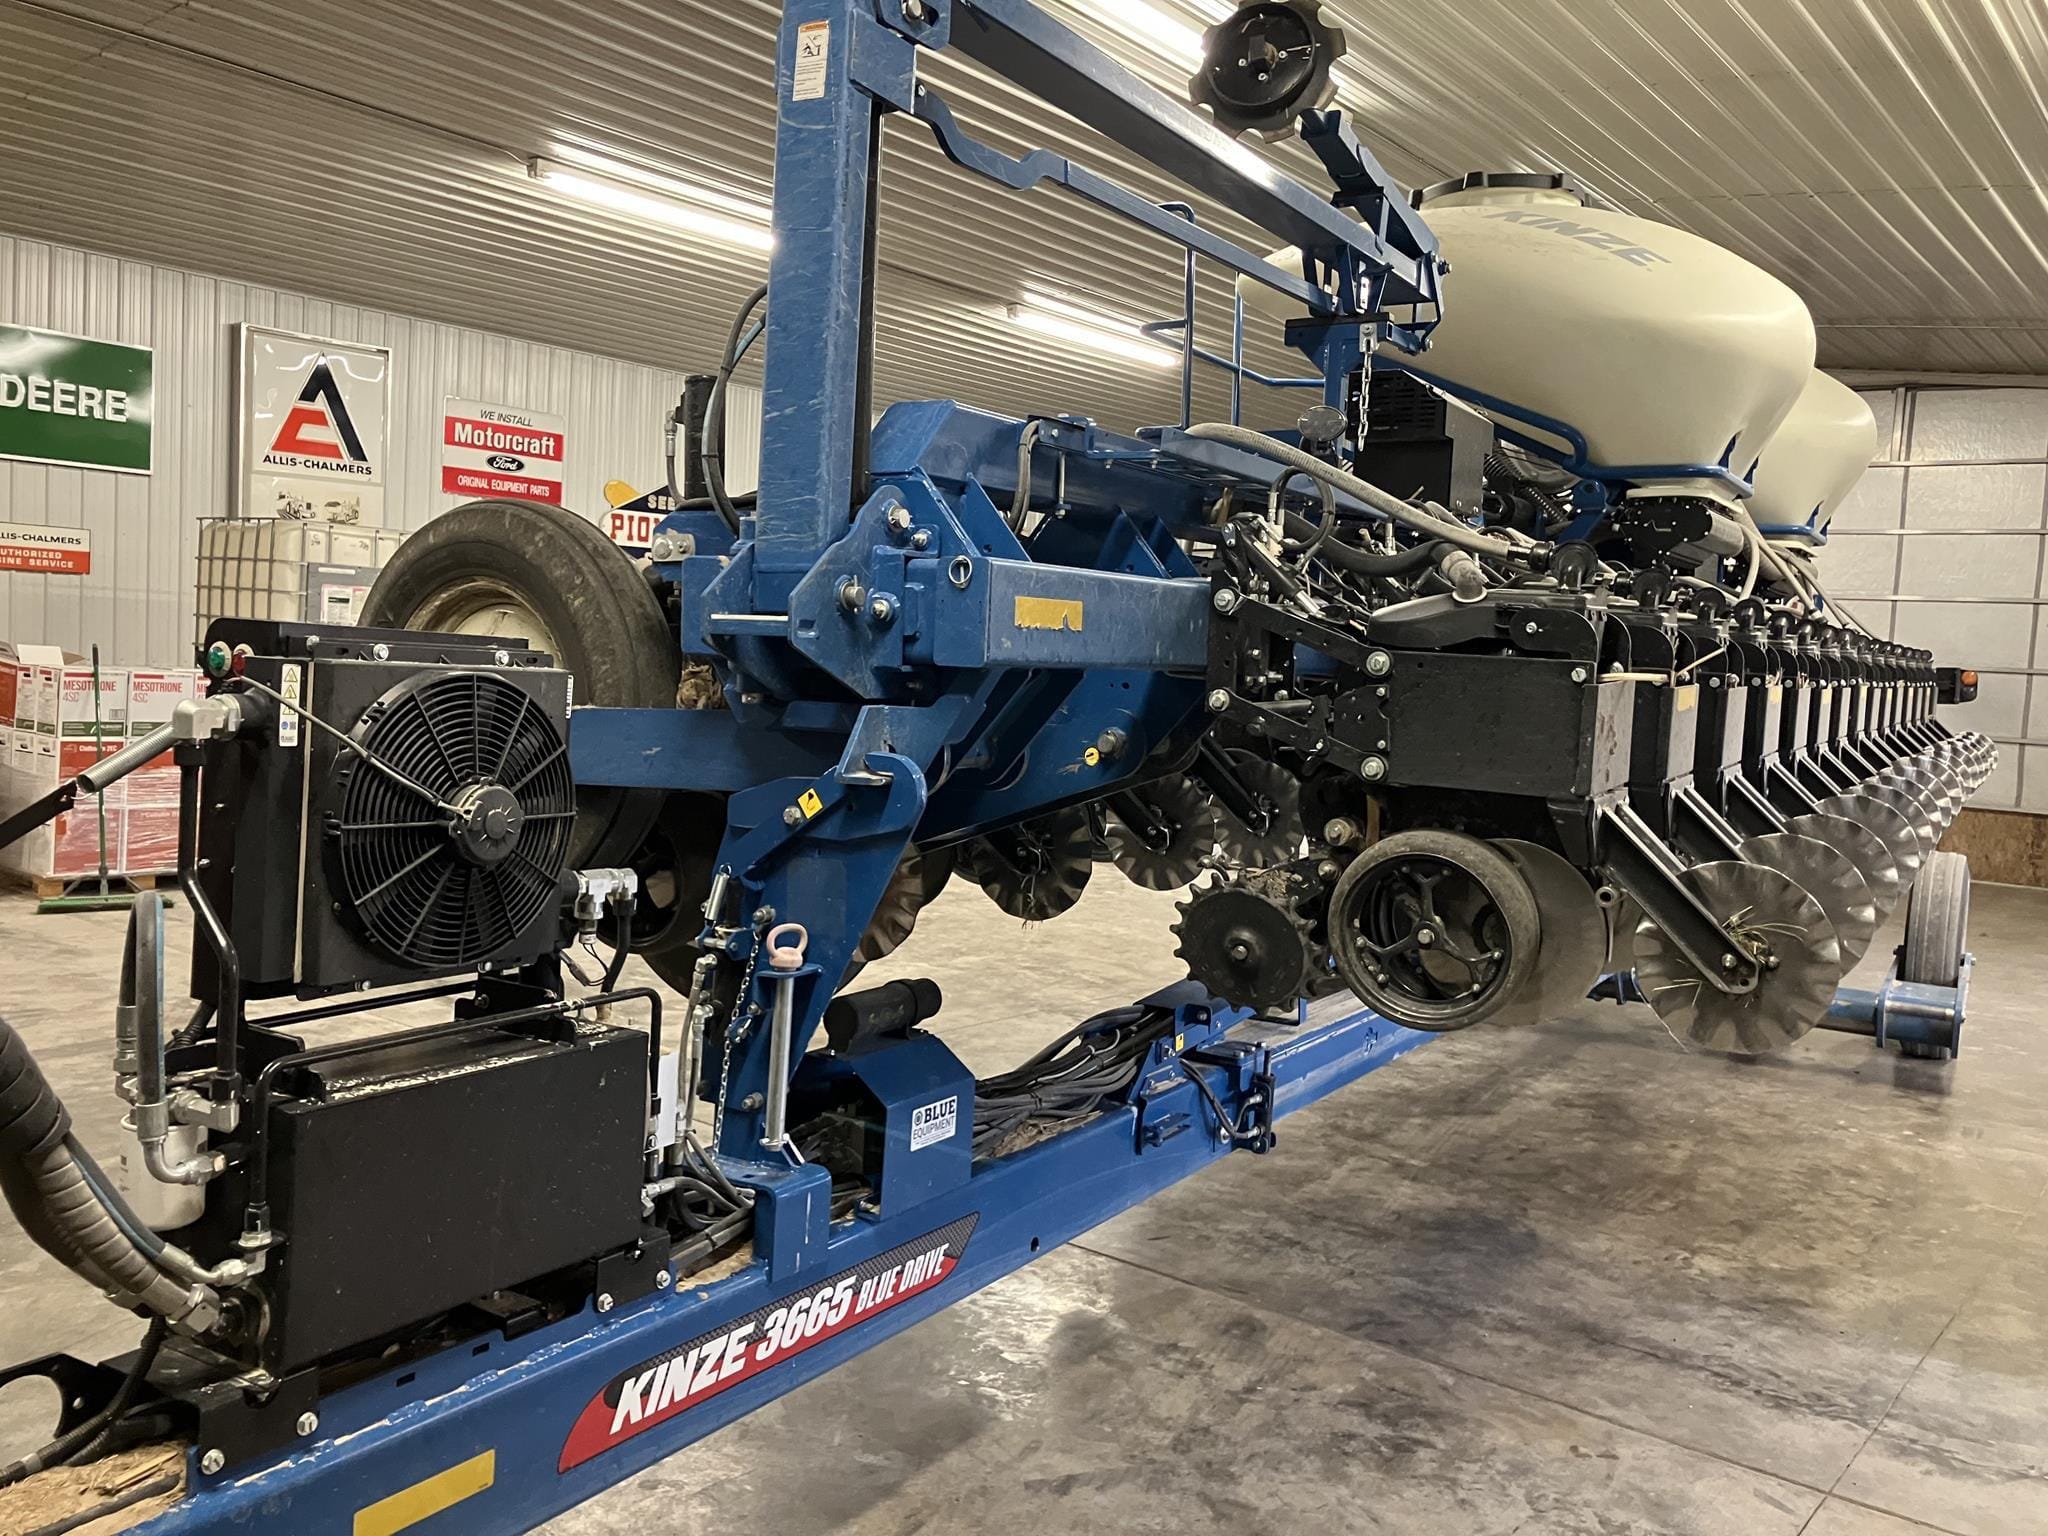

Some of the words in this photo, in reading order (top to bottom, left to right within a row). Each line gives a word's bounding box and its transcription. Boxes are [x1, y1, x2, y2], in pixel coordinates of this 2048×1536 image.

[1481, 211, 1672, 266] KINZE
[0, 373, 128, 422] DEERE
[480, 409, 495, 420] WE
[497, 412, 533, 427] INSTALL
[454, 422, 555, 457] Motorcraft
[262, 454, 373, 475] ALLIS-CHALMERS
[493, 456, 518, 470] Ford
[457, 475, 489, 489] ORIGINAL
[491, 479, 528, 494] EQUIPMENT
[530, 484, 550, 497] PARTS
[647, 494, 676, 511] SEE
[0, 531, 82, 545] LIS-CHALMERS
[610, 513, 660, 543] PIO
[0, 548, 62, 559] UTHORIZED
[28, 558, 75, 568] SERVICE
[63, 680, 117, 691] MESOTONE
[132, 681, 183, 693] MESOTRIONE
[924, 1099, 955, 1124] BLUE
[913, 1116, 954, 1140] EQUIPMENT
[609, 1322, 755, 1435] KINZE
[755, 1275, 858, 1361] 3665
[855, 1265, 902, 1314] BLUE
[897, 1243, 950, 1294] DRIVE
